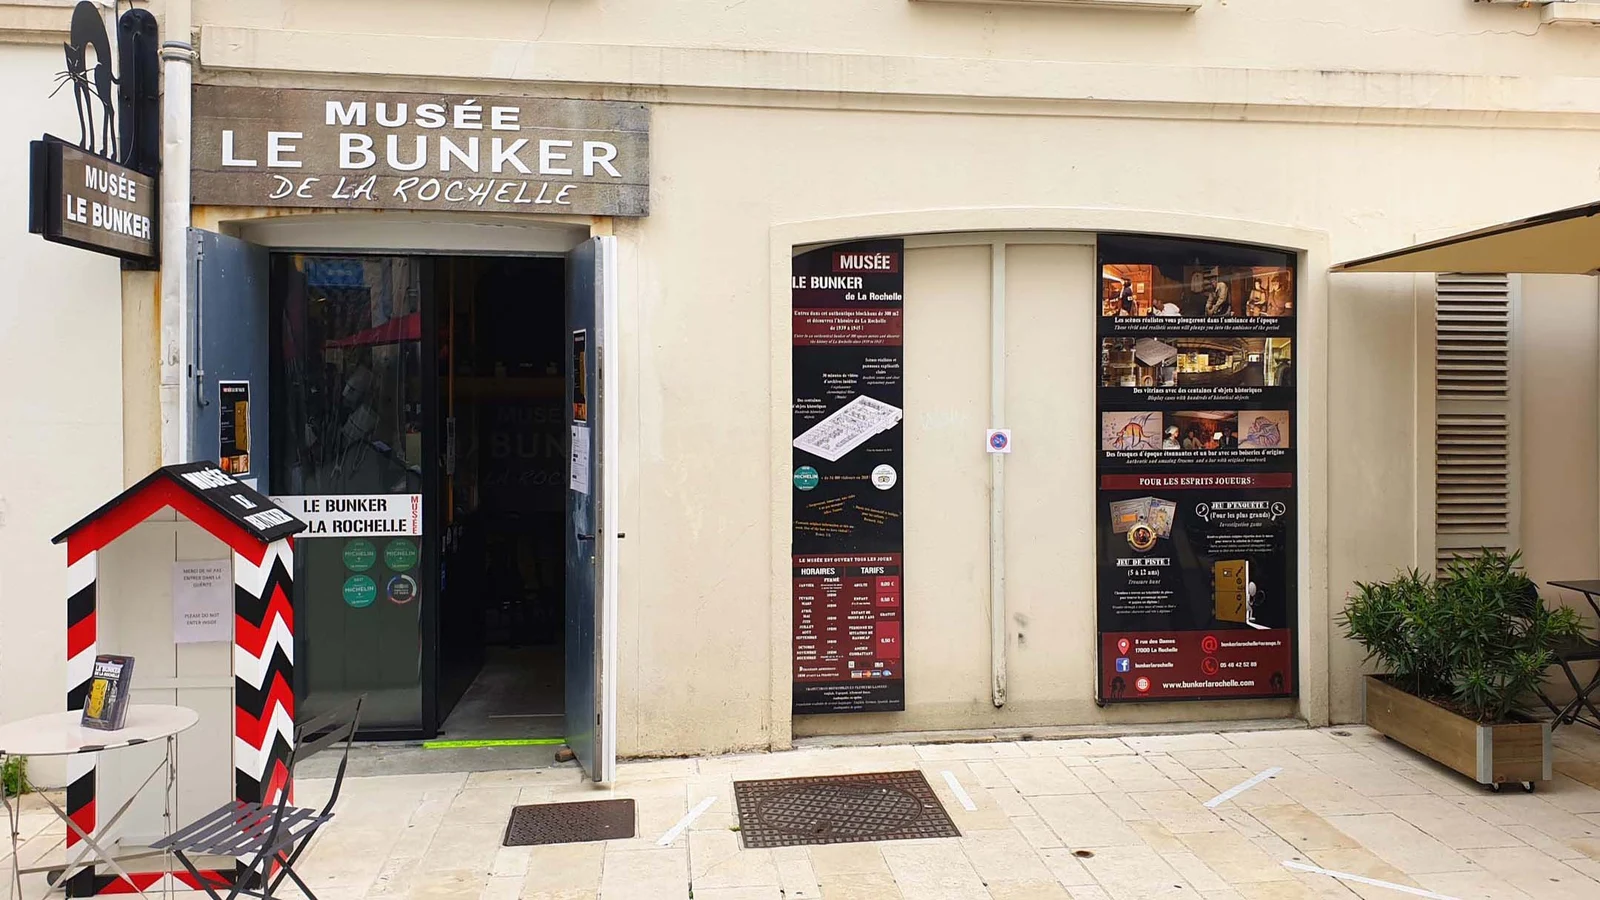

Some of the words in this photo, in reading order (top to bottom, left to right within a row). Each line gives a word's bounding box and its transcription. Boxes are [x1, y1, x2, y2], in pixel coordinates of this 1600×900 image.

[326, 100, 520, 131] MUSÉE
[222, 130, 303, 168] LE
[339, 133, 622, 178] BUNKER
[85, 164, 136, 202] MUSÉE
[269, 175, 320, 199] DE
[331, 174, 377, 200] LA
[393, 177, 577, 206] ROCHELLE
[67, 194, 87, 223] LE
[92, 201, 150, 240] BUNKER
[840, 253, 891, 270] MUSÉE
[792, 276, 806, 289] LE
[810, 276, 863, 289] BUNKER
[845, 292, 855, 301] de
[858, 292, 867, 301] La
[870, 292, 902, 301] Rochelle
[1181, 477, 1213, 485] ESPRITS
[1215, 477, 1251, 485] JOUEURS
[304, 500, 320, 513] LE
[326, 499, 387, 513] BUNKER
[309, 521, 327, 533] LA
[333, 519, 407, 533] ROCHELLE
[1117, 558, 1129, 566] JEU
[1132, 558, 1142, 566] DE
[1145, 558, 1164, 566] PISTE
[1163, 679, 1255, 688] www.bunkerlarochelle.com
